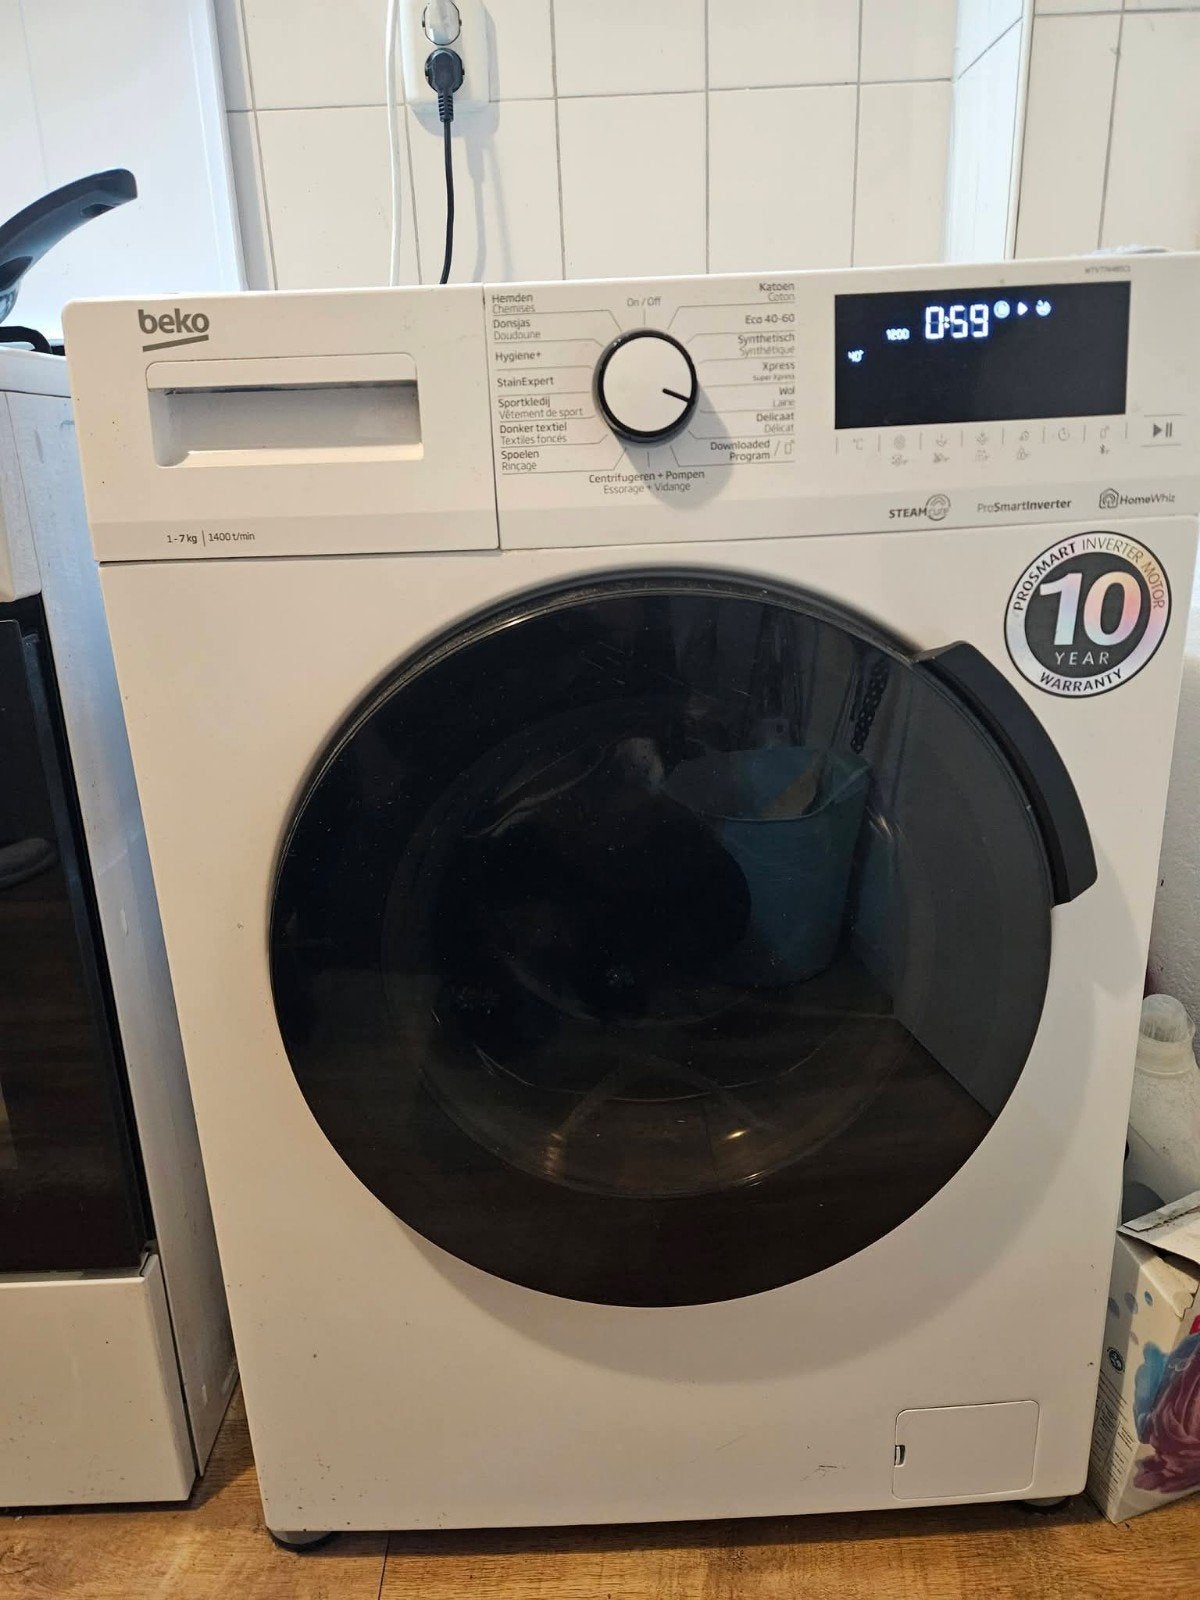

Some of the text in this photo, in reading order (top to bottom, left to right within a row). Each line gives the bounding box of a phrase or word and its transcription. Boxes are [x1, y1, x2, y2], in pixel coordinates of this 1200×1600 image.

[759, 282, 795, 291] Katoen
[492, 293, 533, 303] Hemden
[627, 297, 639, 307] On
[493, 304, 535, 314] Chemises
[137, 308, 209, 334] beko
[493, 319, 531, 330] Donsjas
[745, 313, 795, 324] Eco 40-60
[925, 304, 989, 340] 0:59
[494, 331, 542, 341] Doudoune
[738, 333, 795, 346] Synthetisch
[495, 351, 541, 363] Hygiene+
[762, 361, 795, 371] Xpress
[497, 376, 554, 388] StainExpert
[779, 386, 795, 395] Wol
[498, 397, 551, 409] Sportkledij
[546, 408, 558, 417] de
[559, 407, 583, 419] sport
[756, 412, 794, 422] Delicaat
[500, 422, 567, 434] Donker textiel
[501, 436, 535, 446] Textiles
[710, 440, 770, 451] Downloaded
[501, 450, 540, 460] Spoelen
[729, 451, 770, 463] Program
[589, 473, 656, 484] Centrifugeren
[665, 470, 705, 480] Pompen
[604, 484, 645, 495] Essorage
[654, 482, 692, 493] Vidange
[977, 499, 1073, 513] ProSmartInverter
[208, 532, 231, 542] 1400
[1013, 537, 1166, 612] PROSMART INVERTER MOTOR
[1040, 571, 1142, 646] 10
[1055, 652, 1109, 666] YEAR
[1040, 668, 1123, 692] WARRANTY
